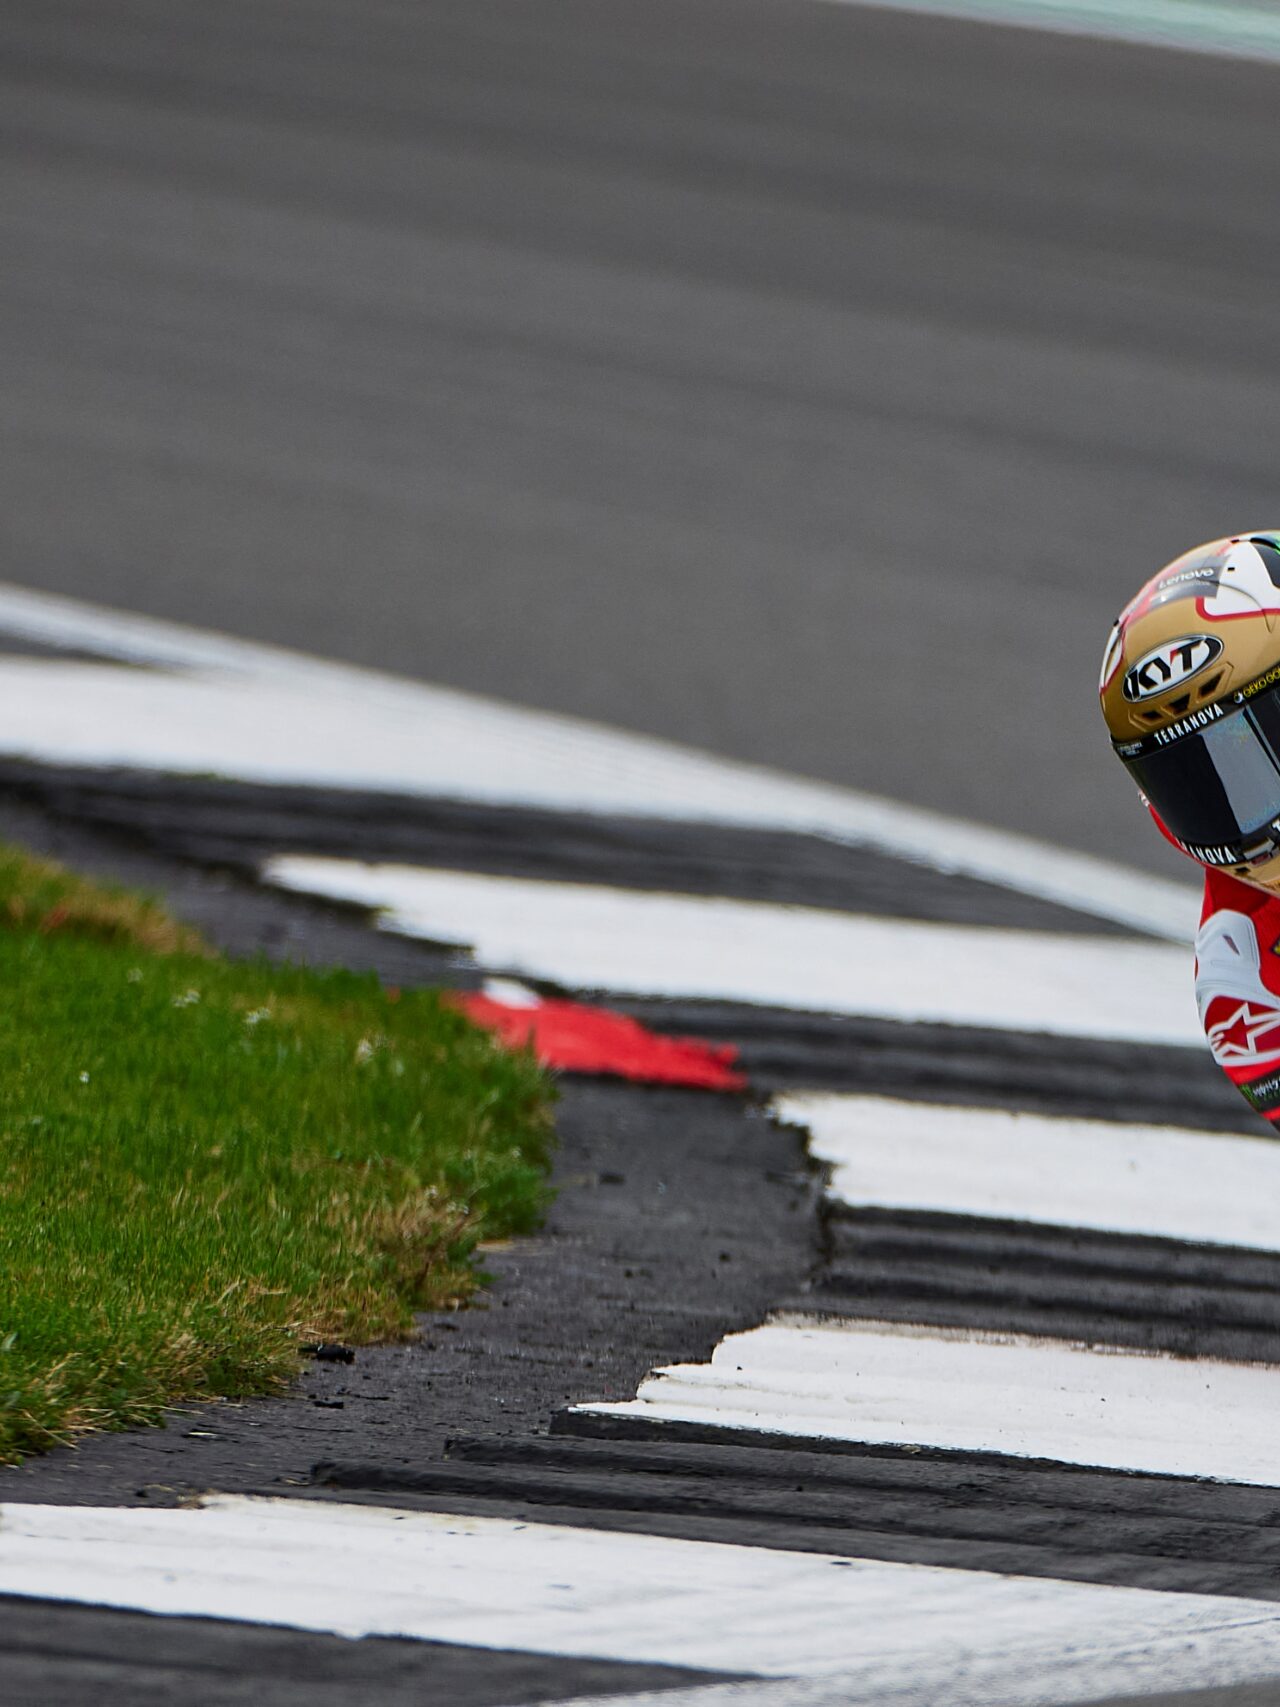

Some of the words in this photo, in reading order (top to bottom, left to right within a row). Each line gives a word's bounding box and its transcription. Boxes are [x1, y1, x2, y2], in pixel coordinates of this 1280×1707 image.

[1159, 567, 1214, 590] Lenovo
[1126, 643, 1203, 696] KYT
[1153, 703, 1224, 745] TERRANOVA
